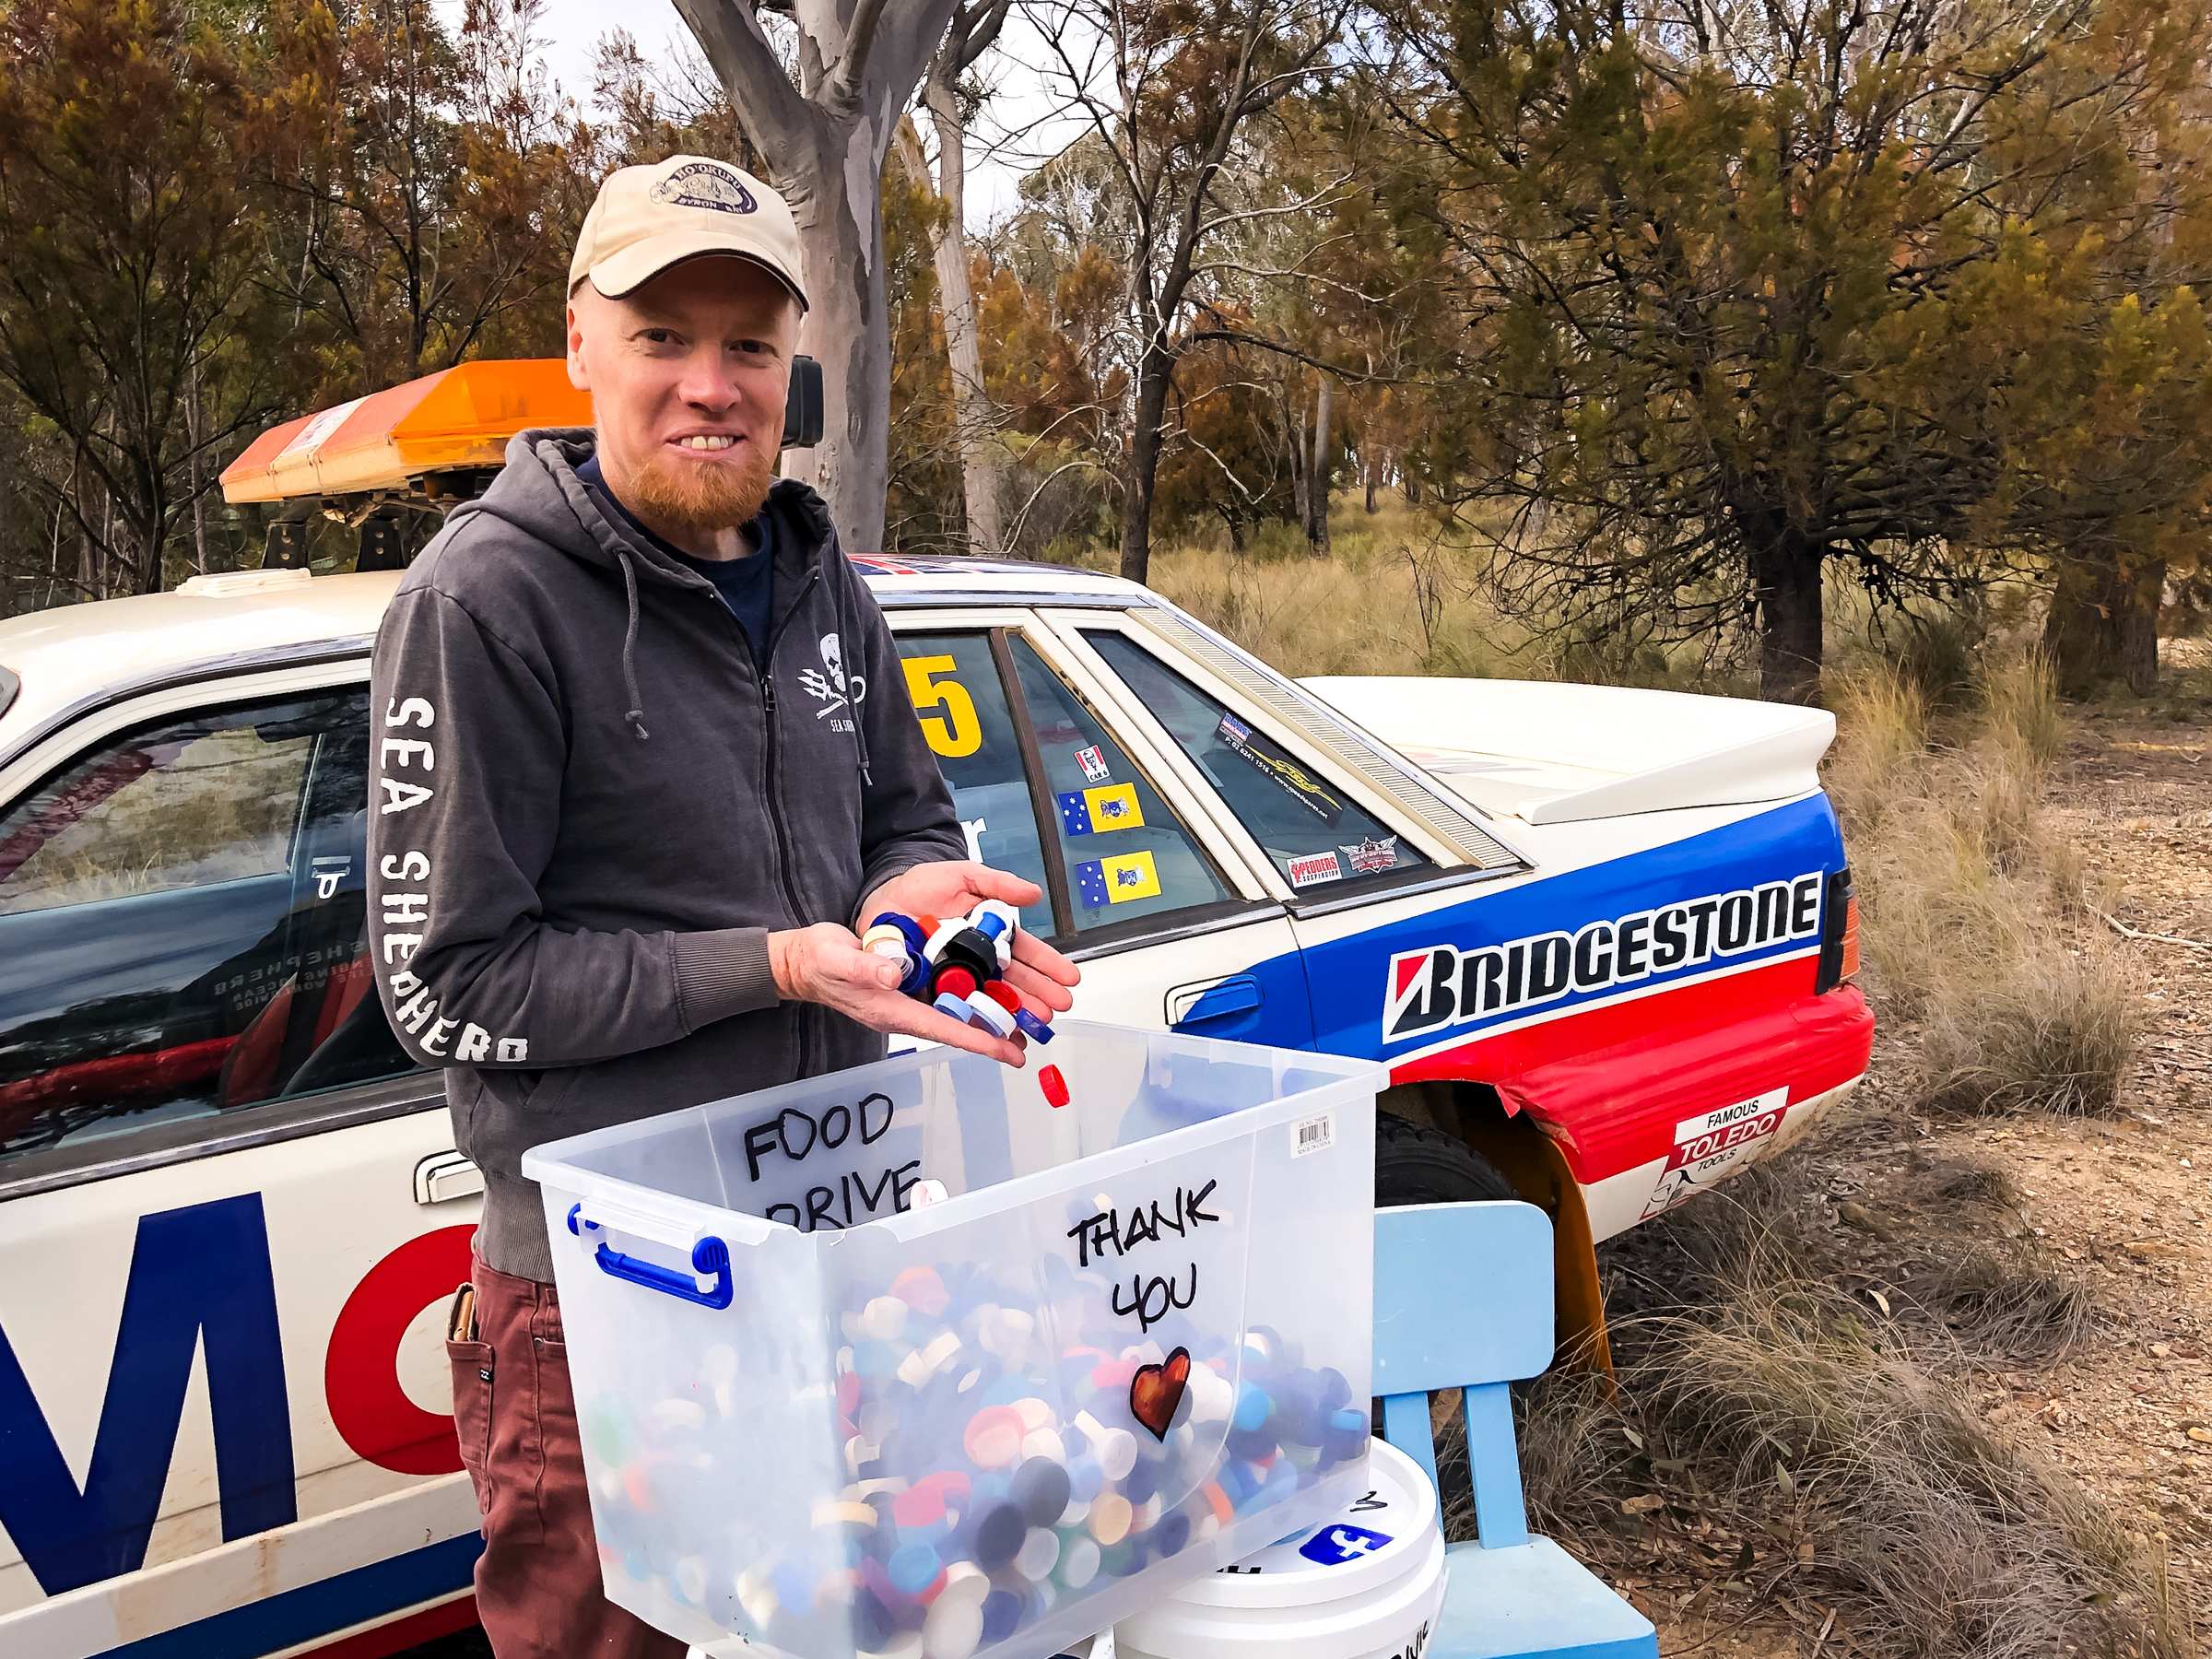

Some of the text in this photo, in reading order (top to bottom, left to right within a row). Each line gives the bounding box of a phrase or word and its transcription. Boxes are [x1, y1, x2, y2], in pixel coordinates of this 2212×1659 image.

[677, 197, 717, 208] BYRON
[830, 718, 843, 732] SEA
[901, 654, 982, 758] 5
[1089, 772, 1102, 781] CAR
[380, 696, 529, 1064] SEA SHEPHERD
[1300, 856, 1338, 875] PEDDERS
[1388, 877, 1818, 1037] BRIDGESTONE
[743, 1092, 895, 1182] FOOD
[1680, 1112, 1777, 1164] TOLEDO
[1706, 1100, 1759, 1129] FAMOUS
[1697, 1148, 1737, 1172] TOOLS
[765, 1159, 923, 1231] DRIVE
[1067, 1178, 1219, 1267] THANK
[1112, 1262, 1198, 1334] YOU
